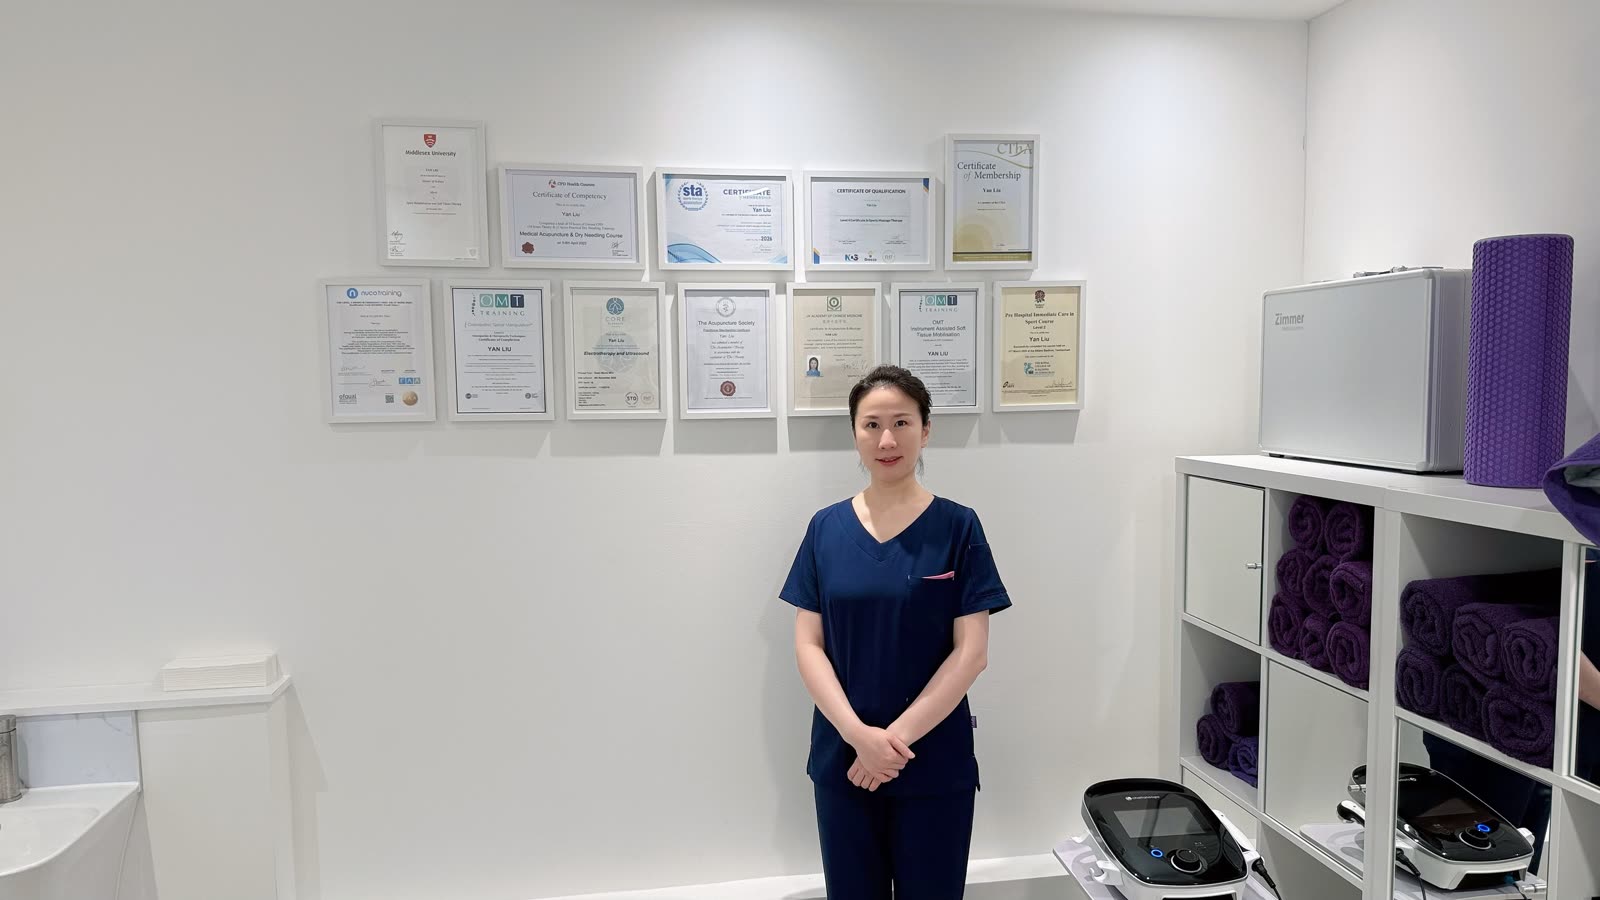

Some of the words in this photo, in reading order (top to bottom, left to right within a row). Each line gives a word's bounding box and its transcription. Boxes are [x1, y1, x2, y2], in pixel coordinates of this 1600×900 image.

[957, 162, 996, 170] Certificate
[964, 171, 971, 181] of
[974, 171, 1021, 181] Membership
[683, 185, 702, 197] sta
[480, 295, 521, 307] OMT
[926, 296, 956, 305] OMT
[1275, 313, 1304, 325] Zimmer
